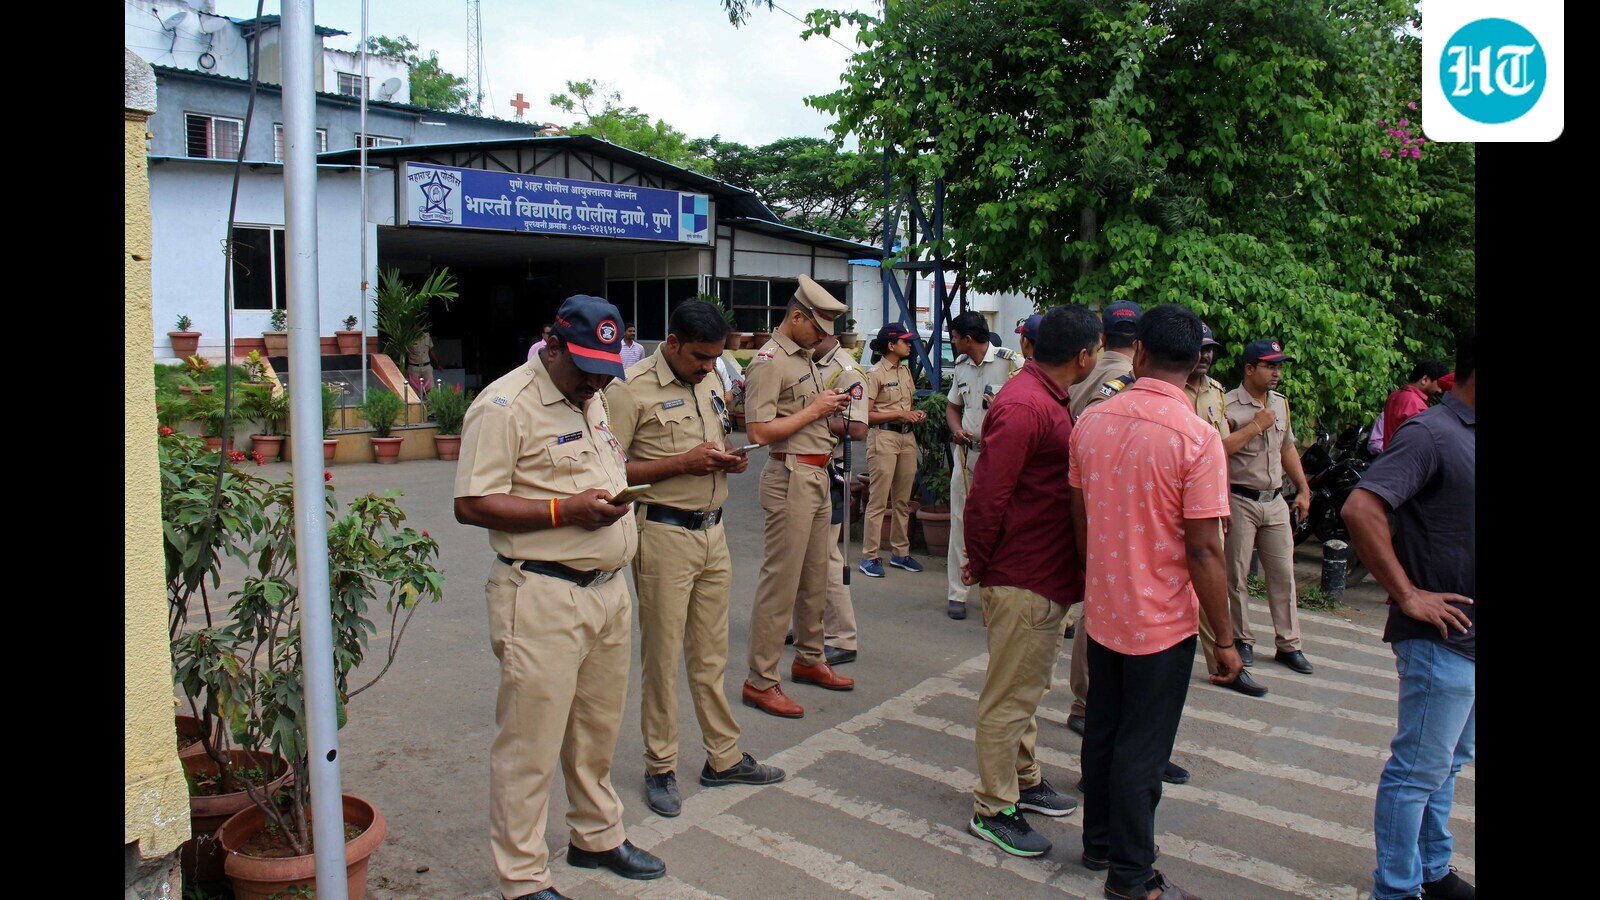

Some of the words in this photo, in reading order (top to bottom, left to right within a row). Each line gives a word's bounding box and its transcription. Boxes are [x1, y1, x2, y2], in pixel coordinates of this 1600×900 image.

[509, 178, 523, 192] पुणे
[525, 181, 543, 192] शहर
[544, 180, 569, 194] पोलीस
[464, 194, 512, 216] भारती
[515, 195, 573, 221] विद्यापीठ
[576, 201, 618, 224] पोलीस
[620, 206, 649, 228] ठाणे,
[652, 209, 672, 233] पुणे
